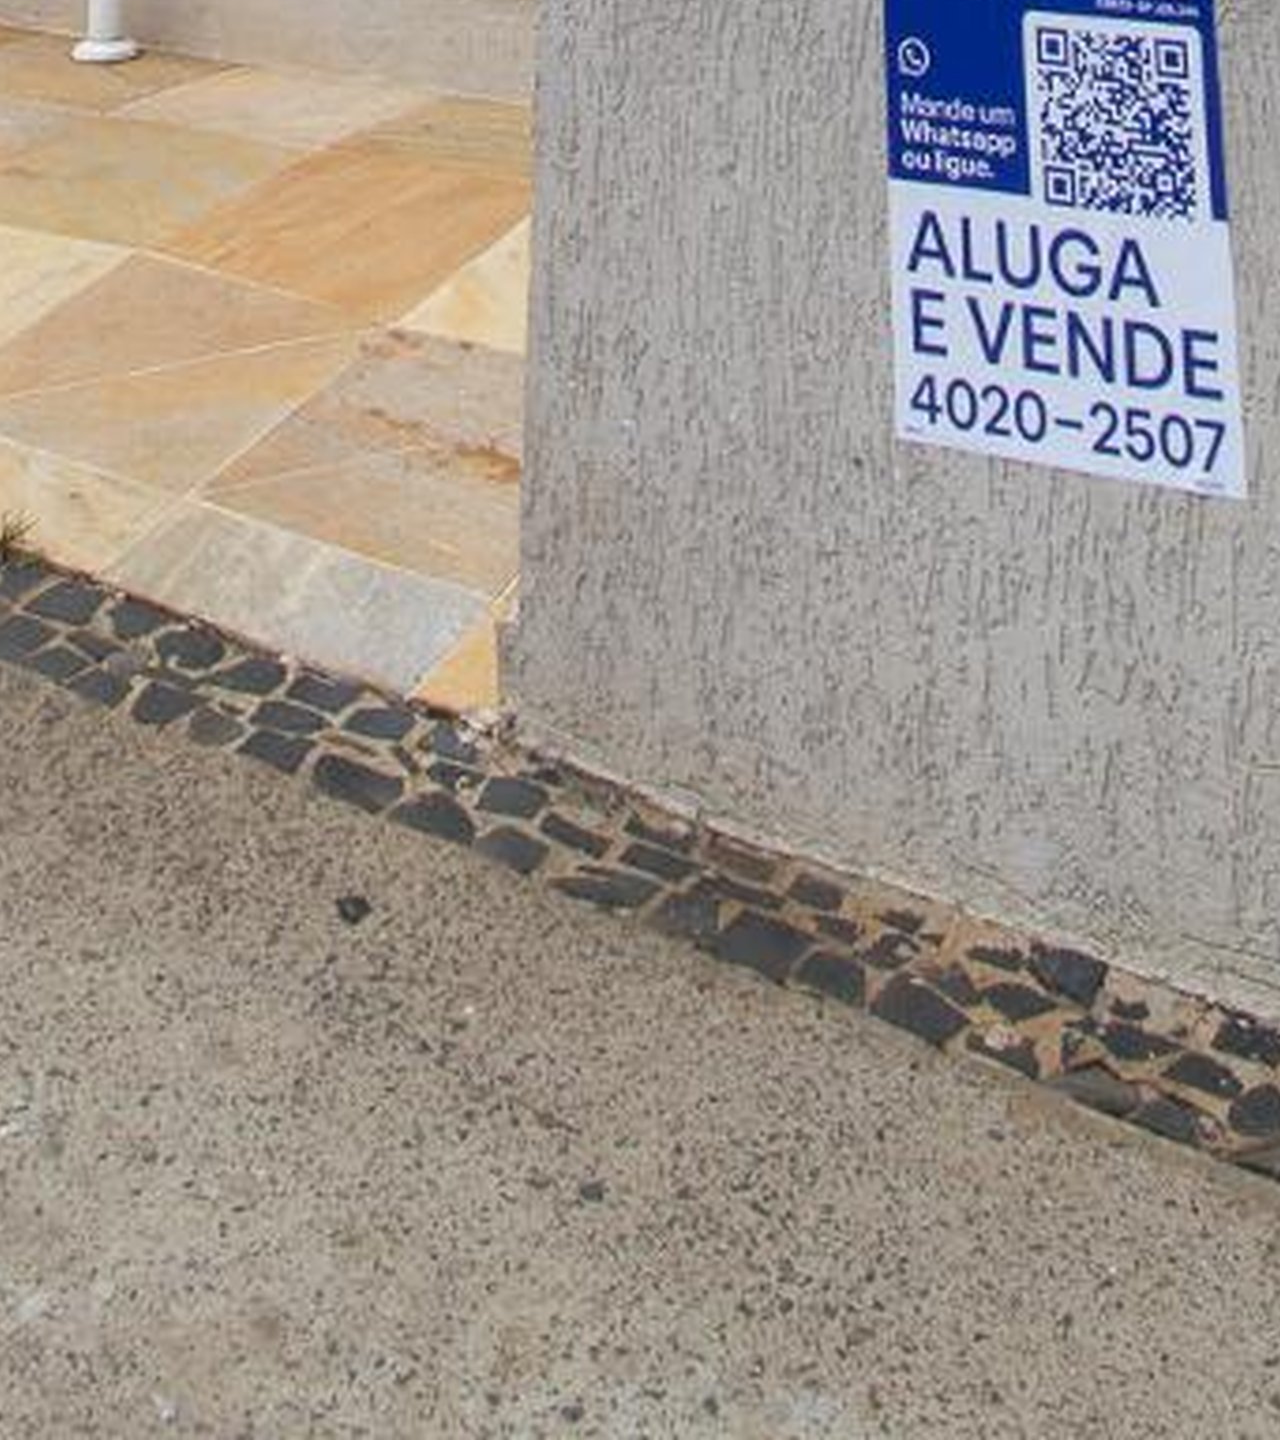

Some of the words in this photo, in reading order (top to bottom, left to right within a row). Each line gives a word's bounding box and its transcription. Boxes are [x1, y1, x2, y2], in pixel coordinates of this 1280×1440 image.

[900, 90, 976, 122] Mande
[979, 104, 1017, 126] um
[900, 150, 933, 172] ou
[907, 210, 1161, 308] ALUGA
[911, 288, 948, 357] E
[965, 296, 1224, 401] VENDE
[910, 375, 1227, 473] 4020-2507
